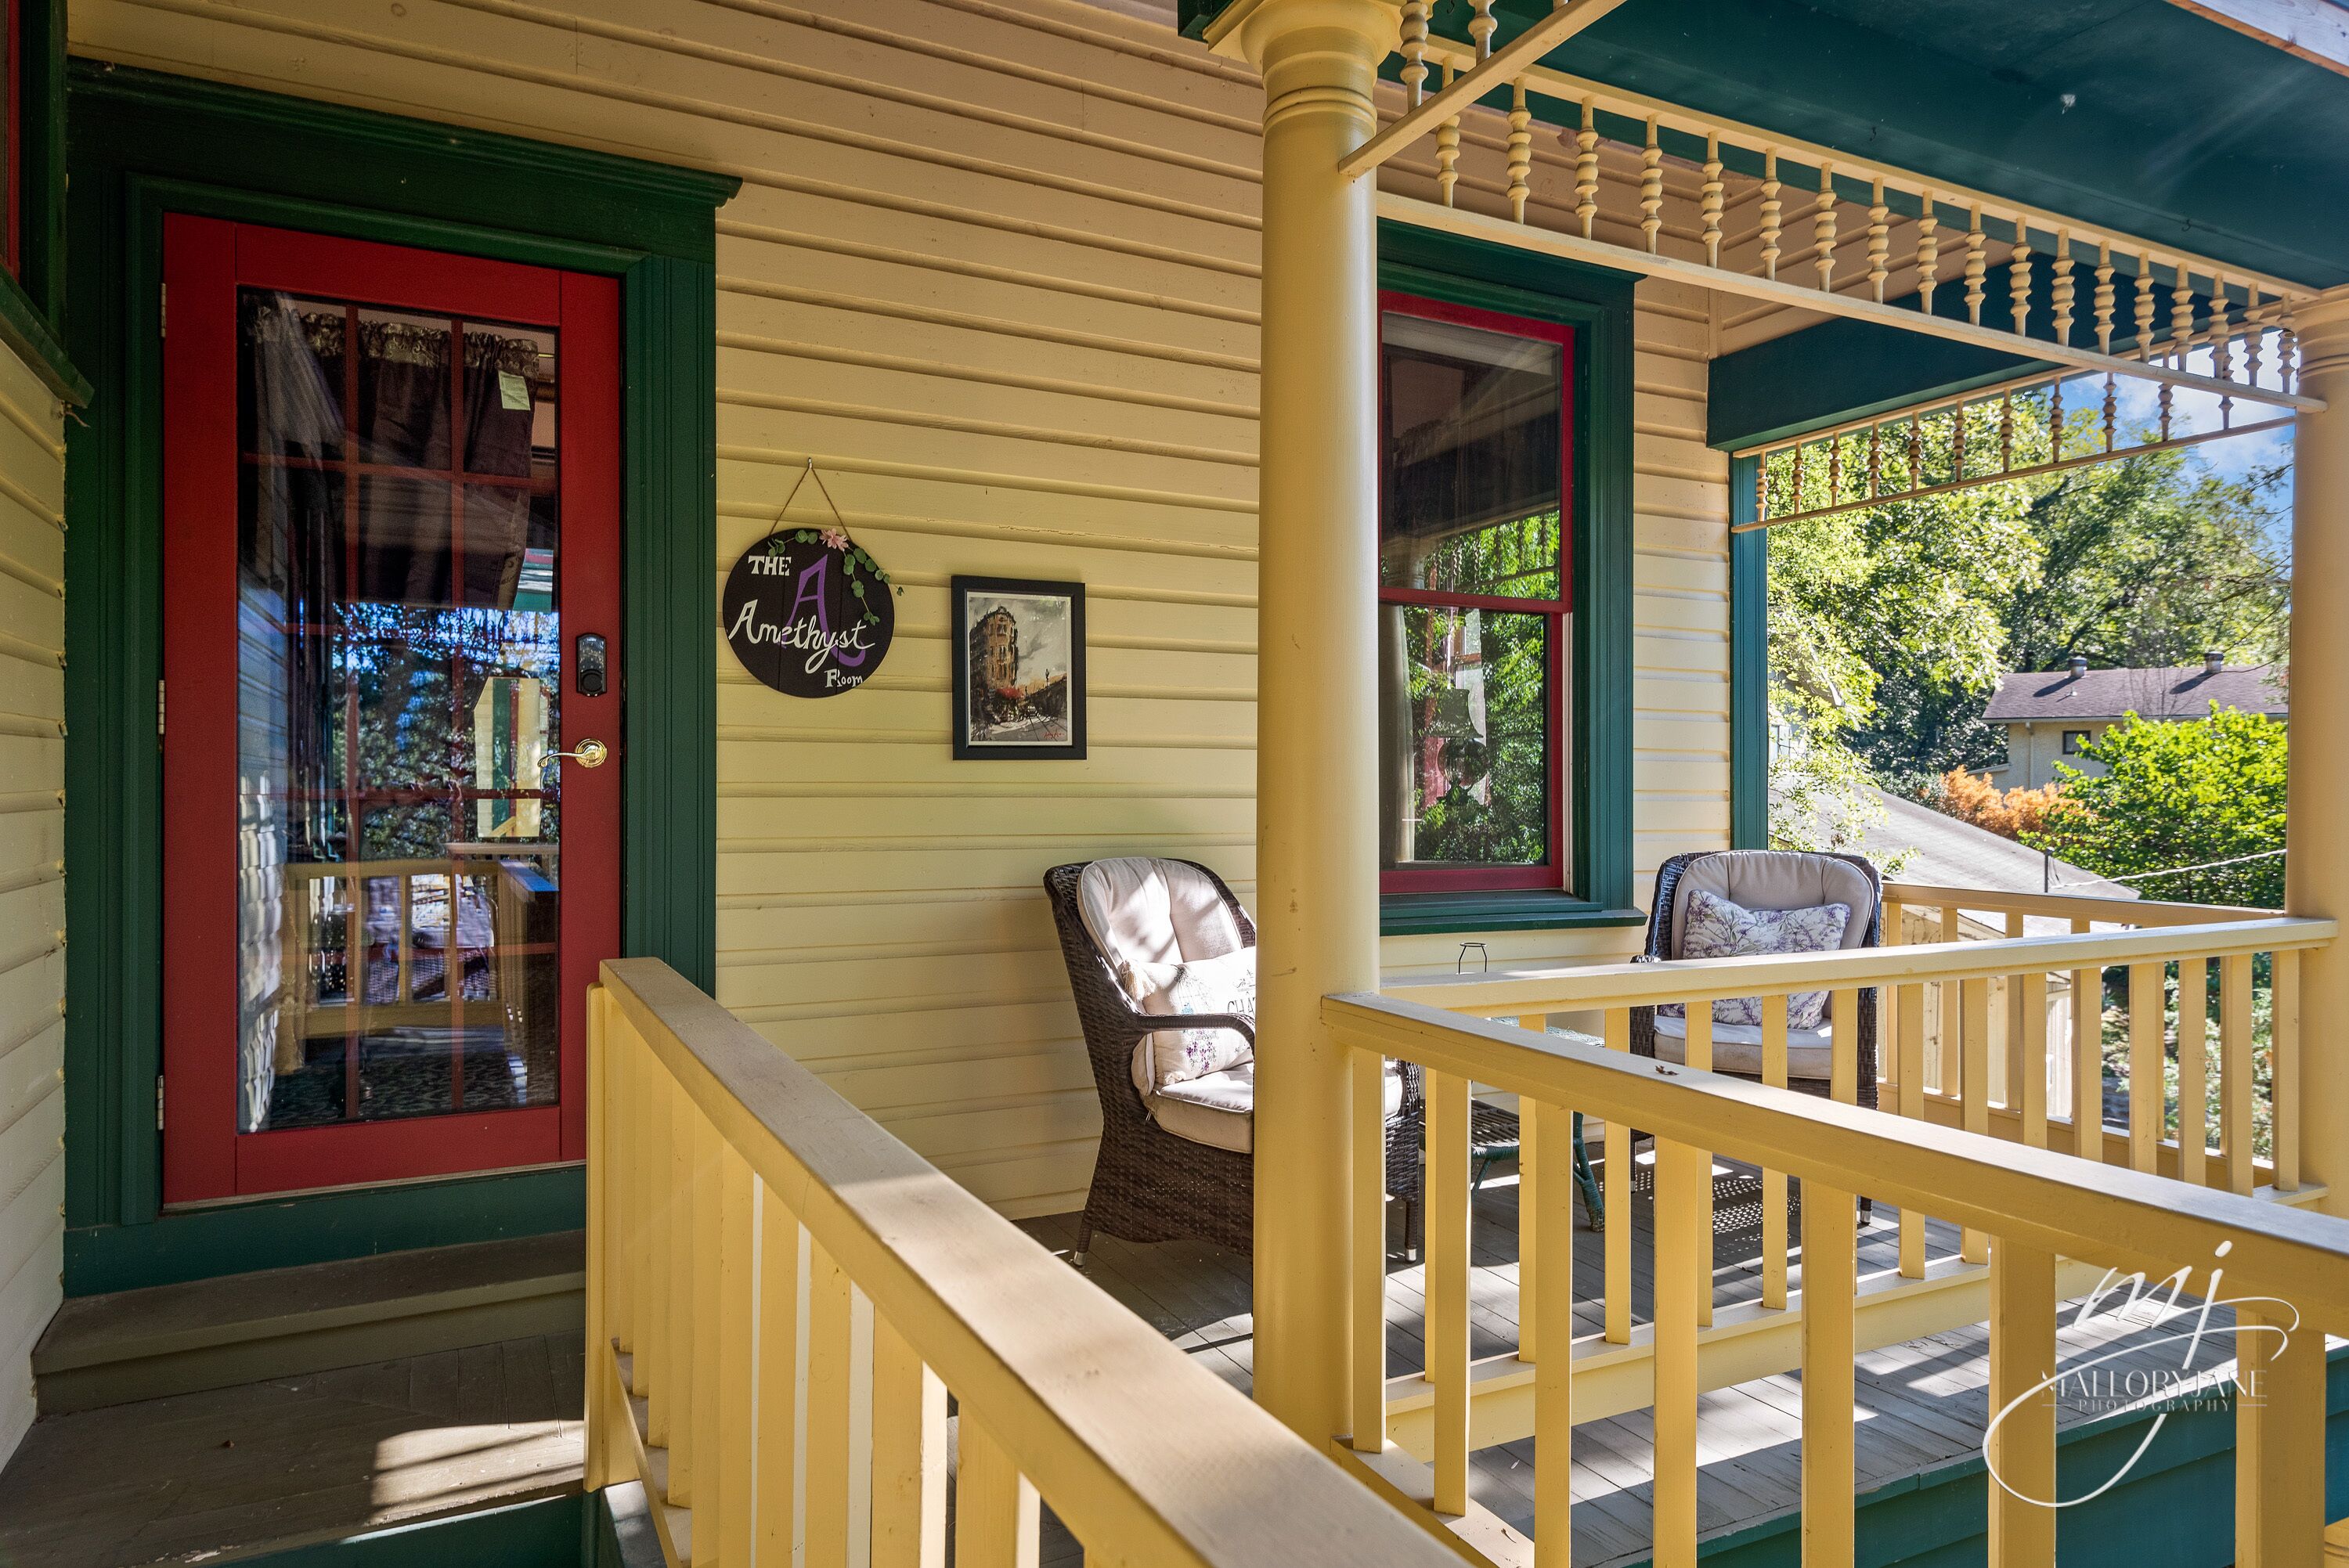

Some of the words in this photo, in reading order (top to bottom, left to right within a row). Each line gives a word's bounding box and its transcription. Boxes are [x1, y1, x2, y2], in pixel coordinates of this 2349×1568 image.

[748, 555, 792, 576] THE
[778, 553, 866, 667] A
[728, 599, 875, 674] Amethyst
[824, 669, 863, 688] Room
